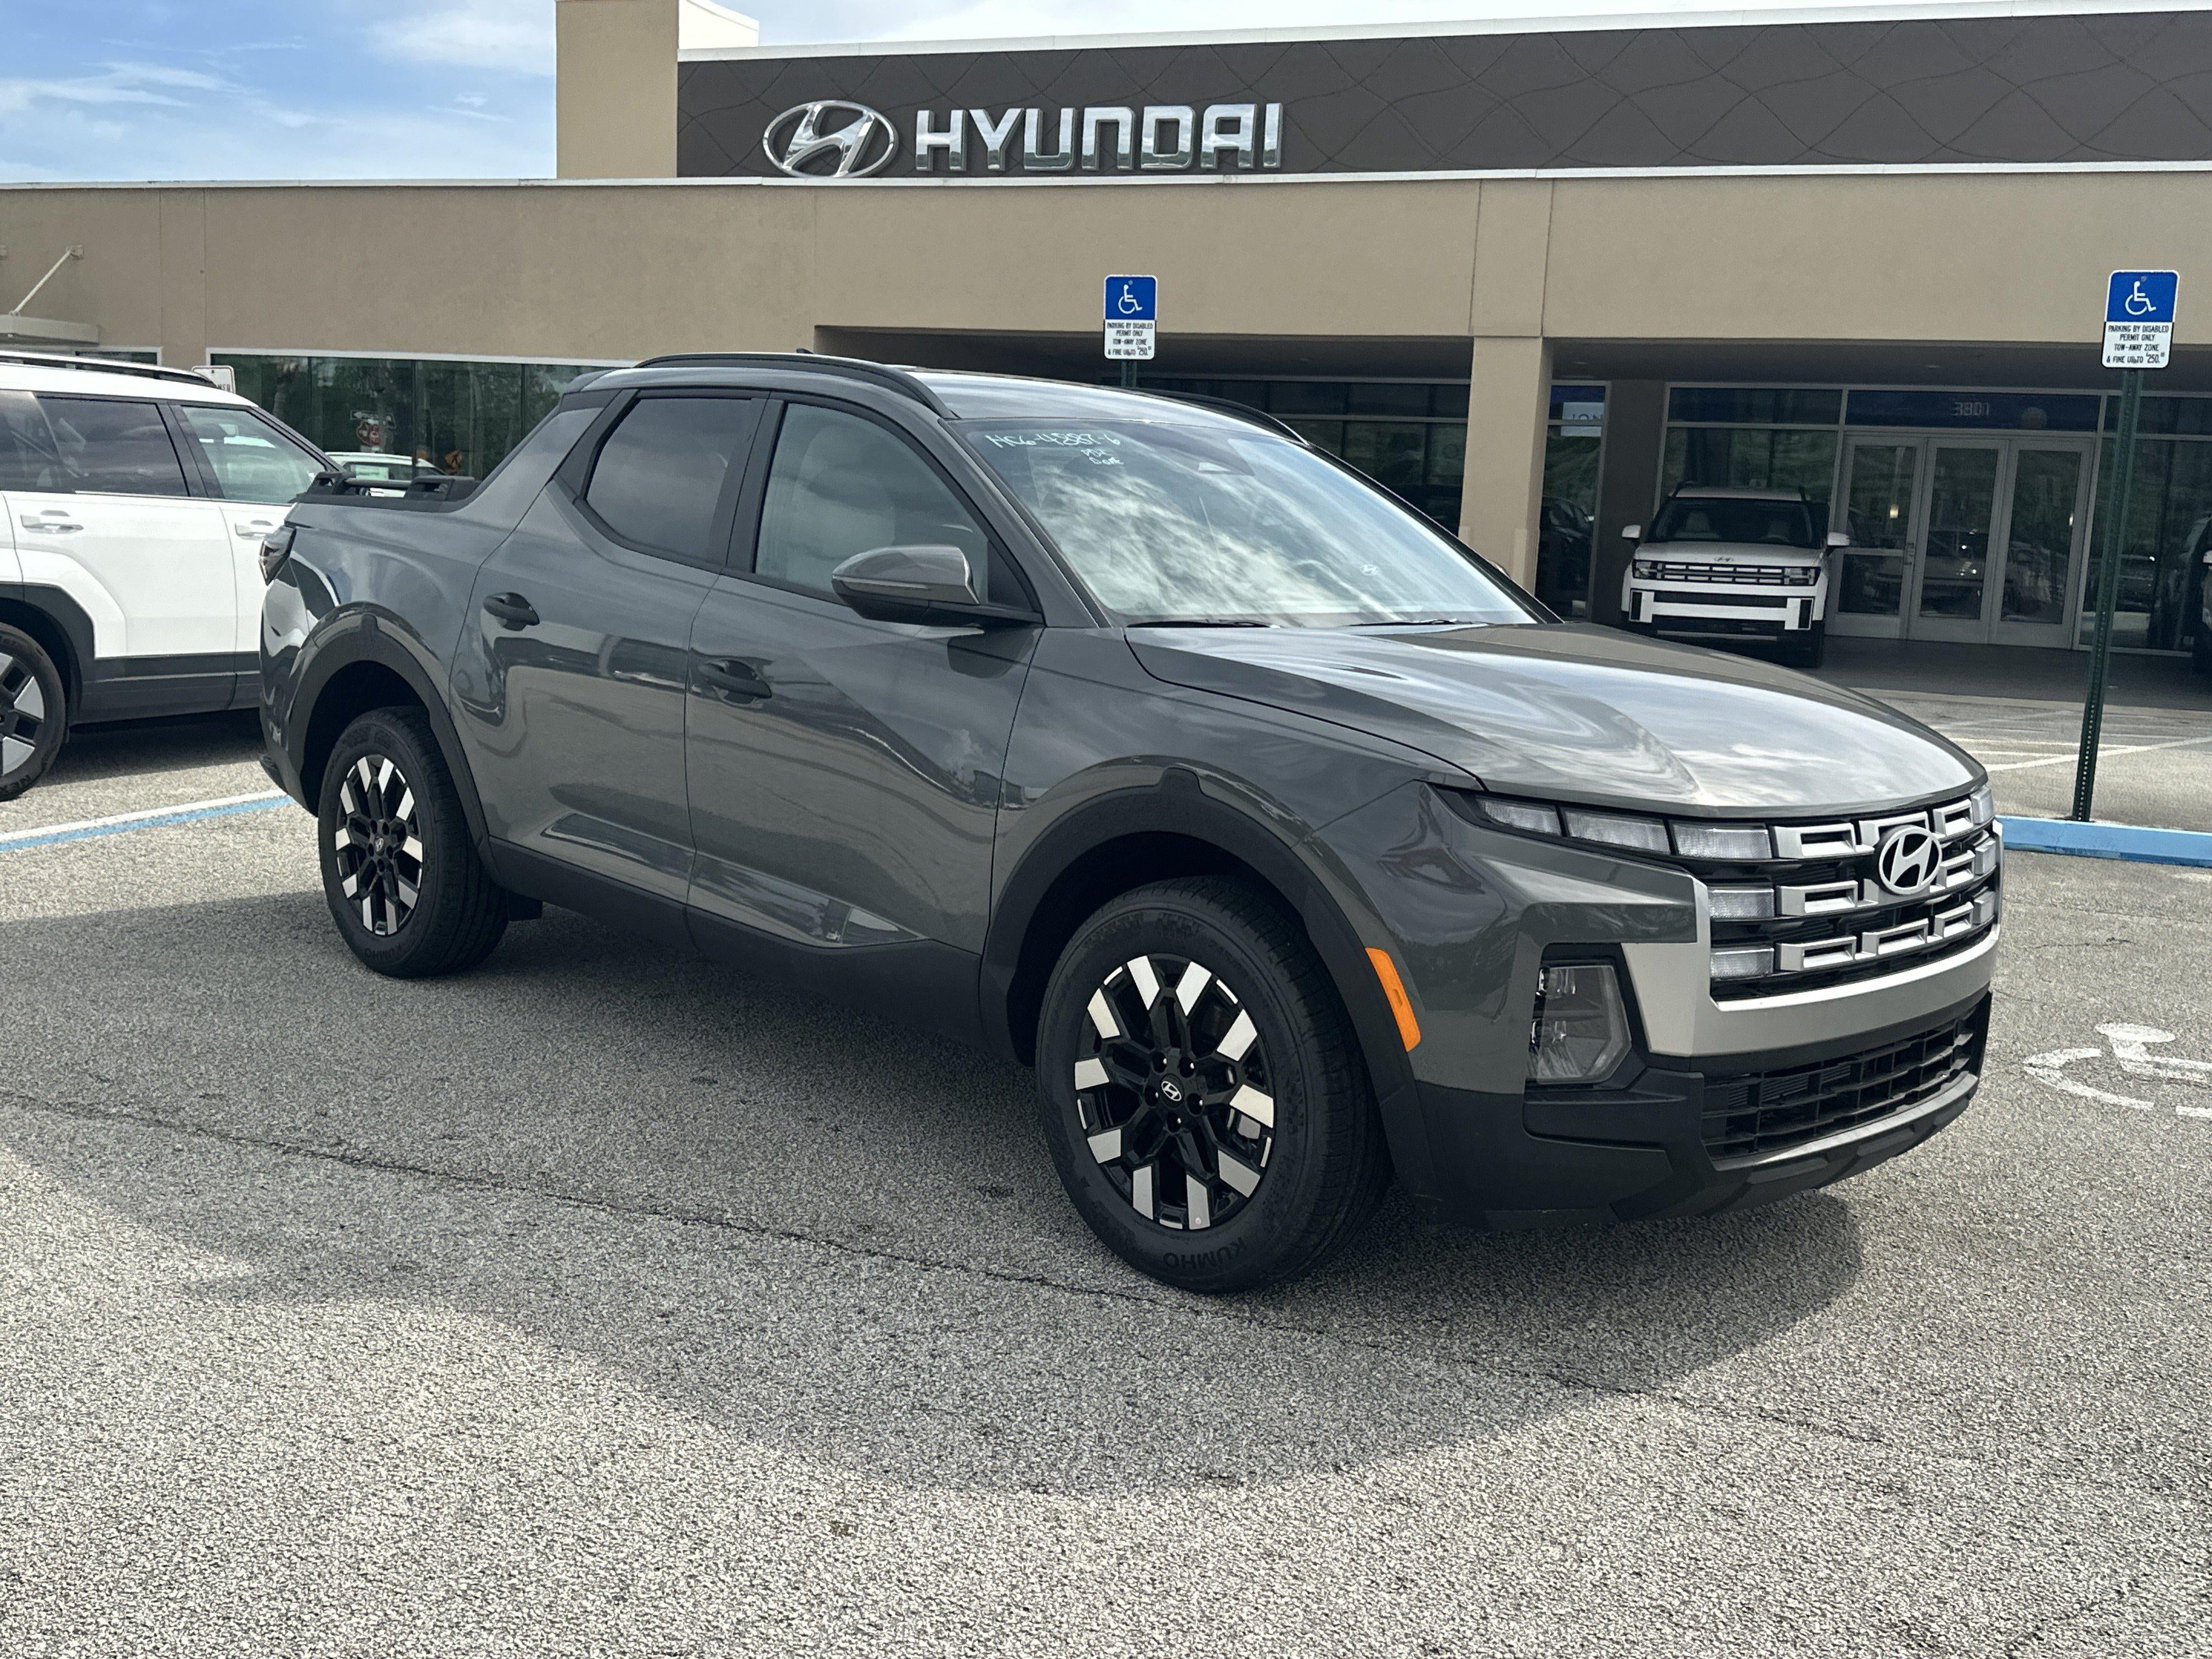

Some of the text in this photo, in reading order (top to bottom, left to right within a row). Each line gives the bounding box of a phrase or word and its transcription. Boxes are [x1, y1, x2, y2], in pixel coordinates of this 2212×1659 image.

[915, 103, 1283, 172] HYUNDAI
[2142, 325, 2169, 333] DISABLED
[1163, 1237, 1247, 1269] KUMHO
